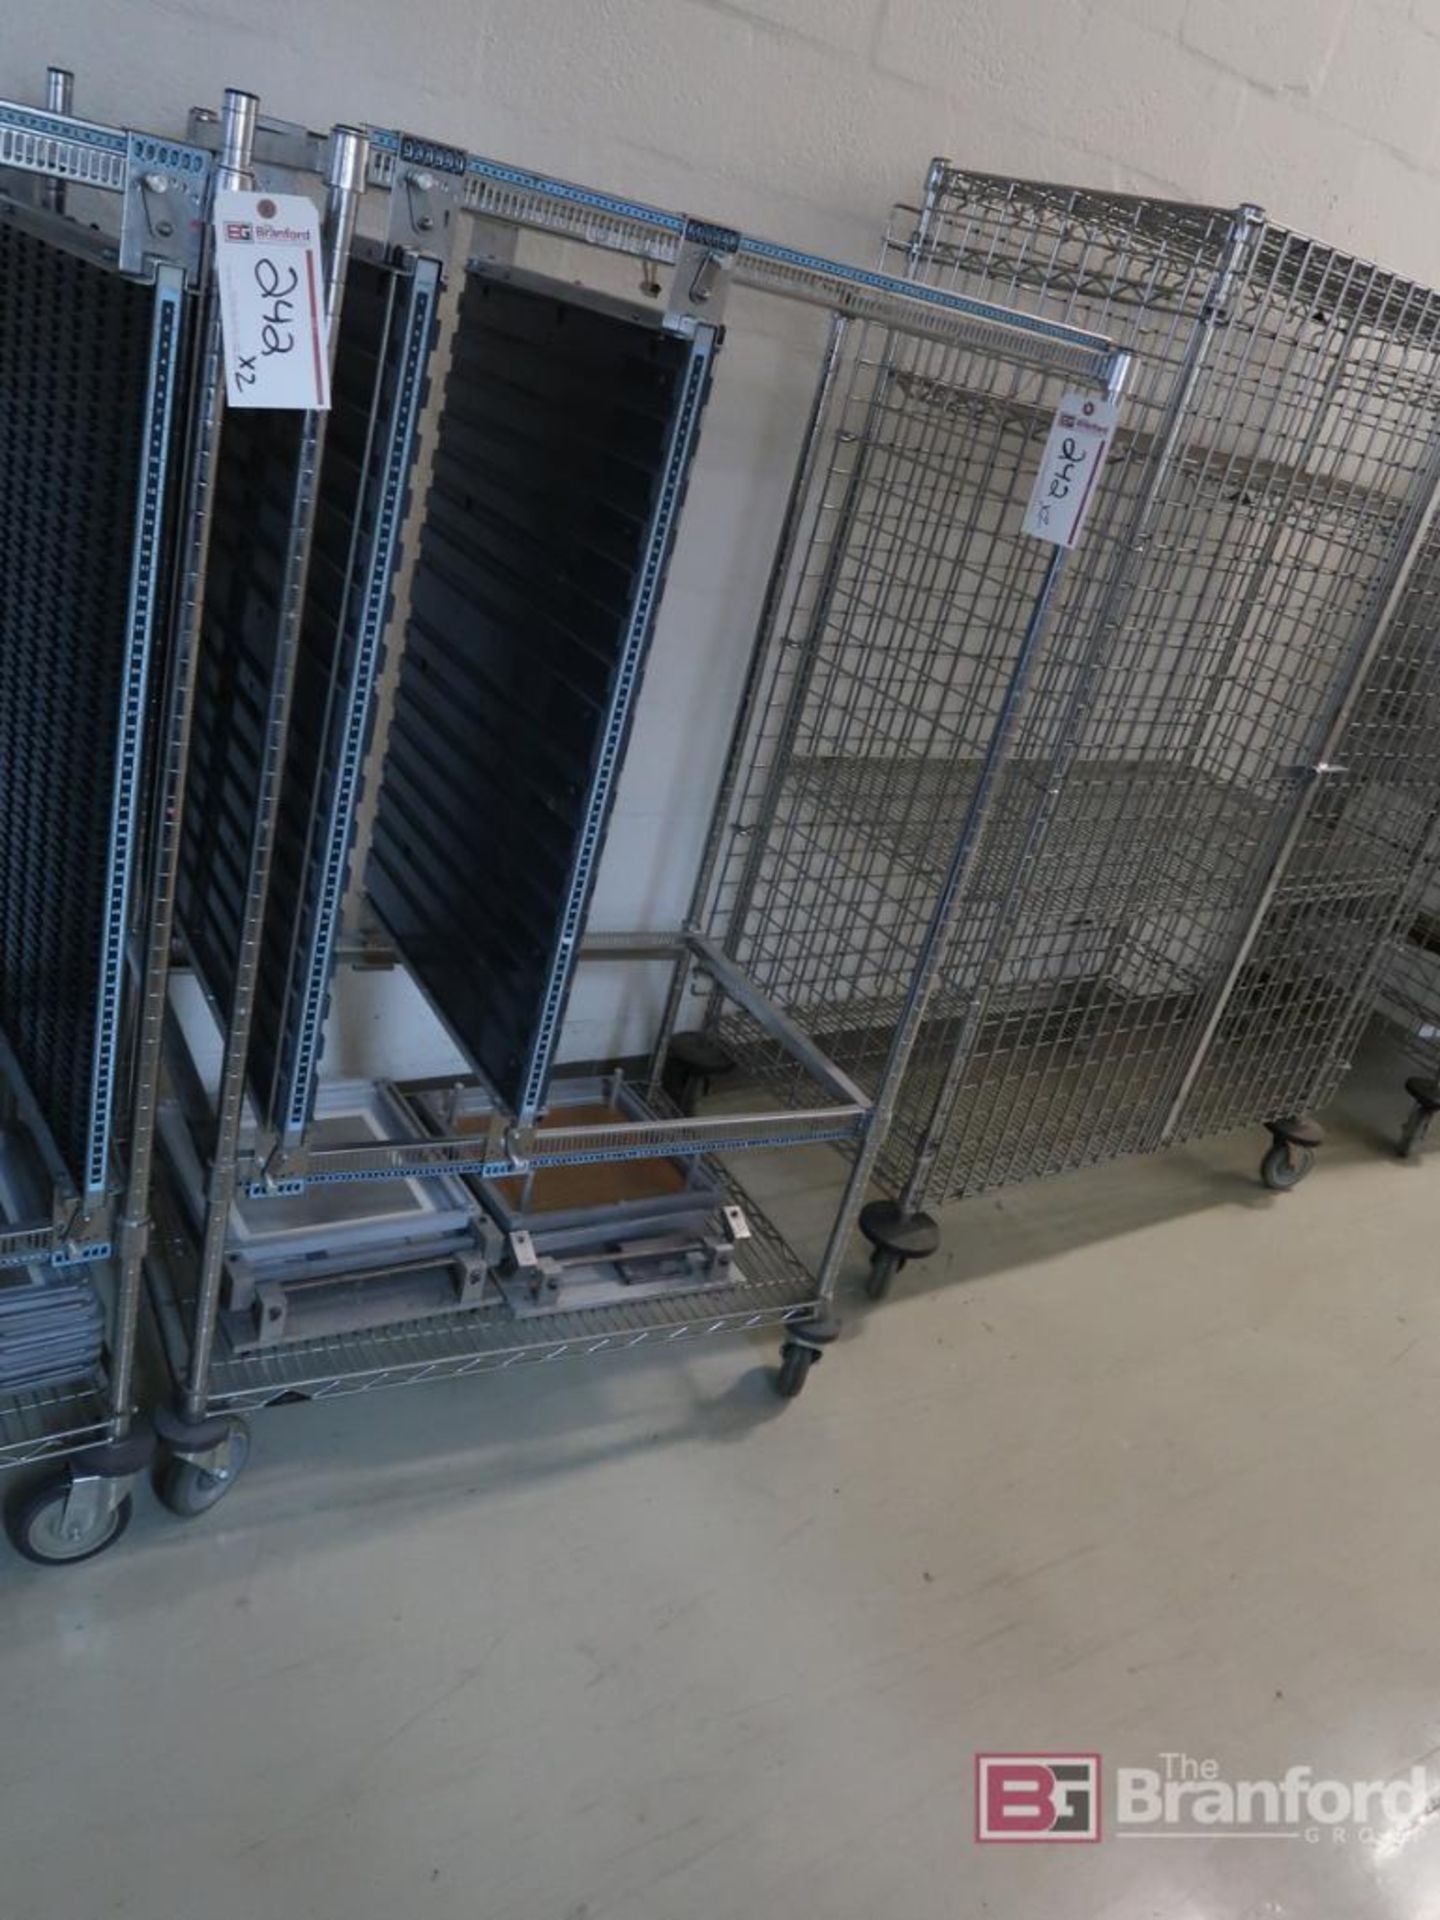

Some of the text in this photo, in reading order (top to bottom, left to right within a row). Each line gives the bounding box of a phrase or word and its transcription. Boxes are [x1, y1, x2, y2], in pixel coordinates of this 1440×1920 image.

[255, 225, 310, 242] Branford
[254, 257, 299, 357] 242
[1048, 437, 1087, 500] 242
